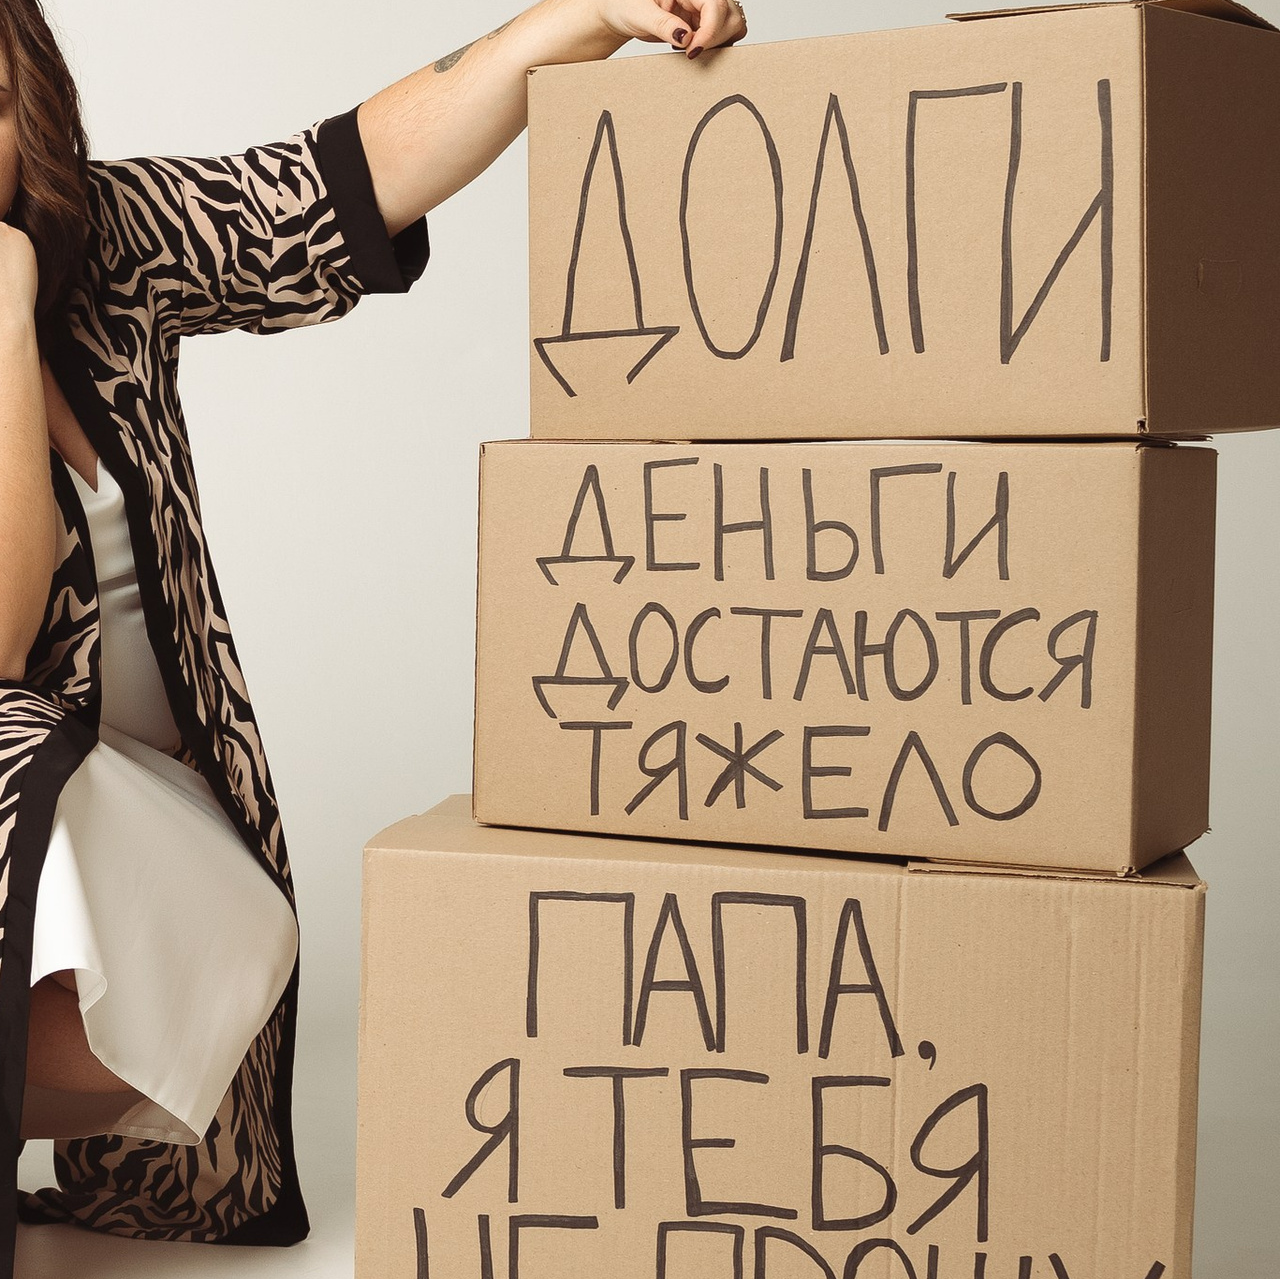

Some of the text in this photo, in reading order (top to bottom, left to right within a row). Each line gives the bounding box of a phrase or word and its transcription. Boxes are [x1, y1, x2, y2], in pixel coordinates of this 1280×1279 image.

[534, 78, 1115, 397] ДОЛГИ
[536, 456, 1010, 586] ДЕНЬГИ
[531, 600, 1099, 720] ДОСТАЮТСЯ
[559, 720, 1044, 832] ТЯЖЕЛО
[525, 890, 938, 1072] ПАПА,
[441, 1057, 989, 1243] Я ТЕБЯ
